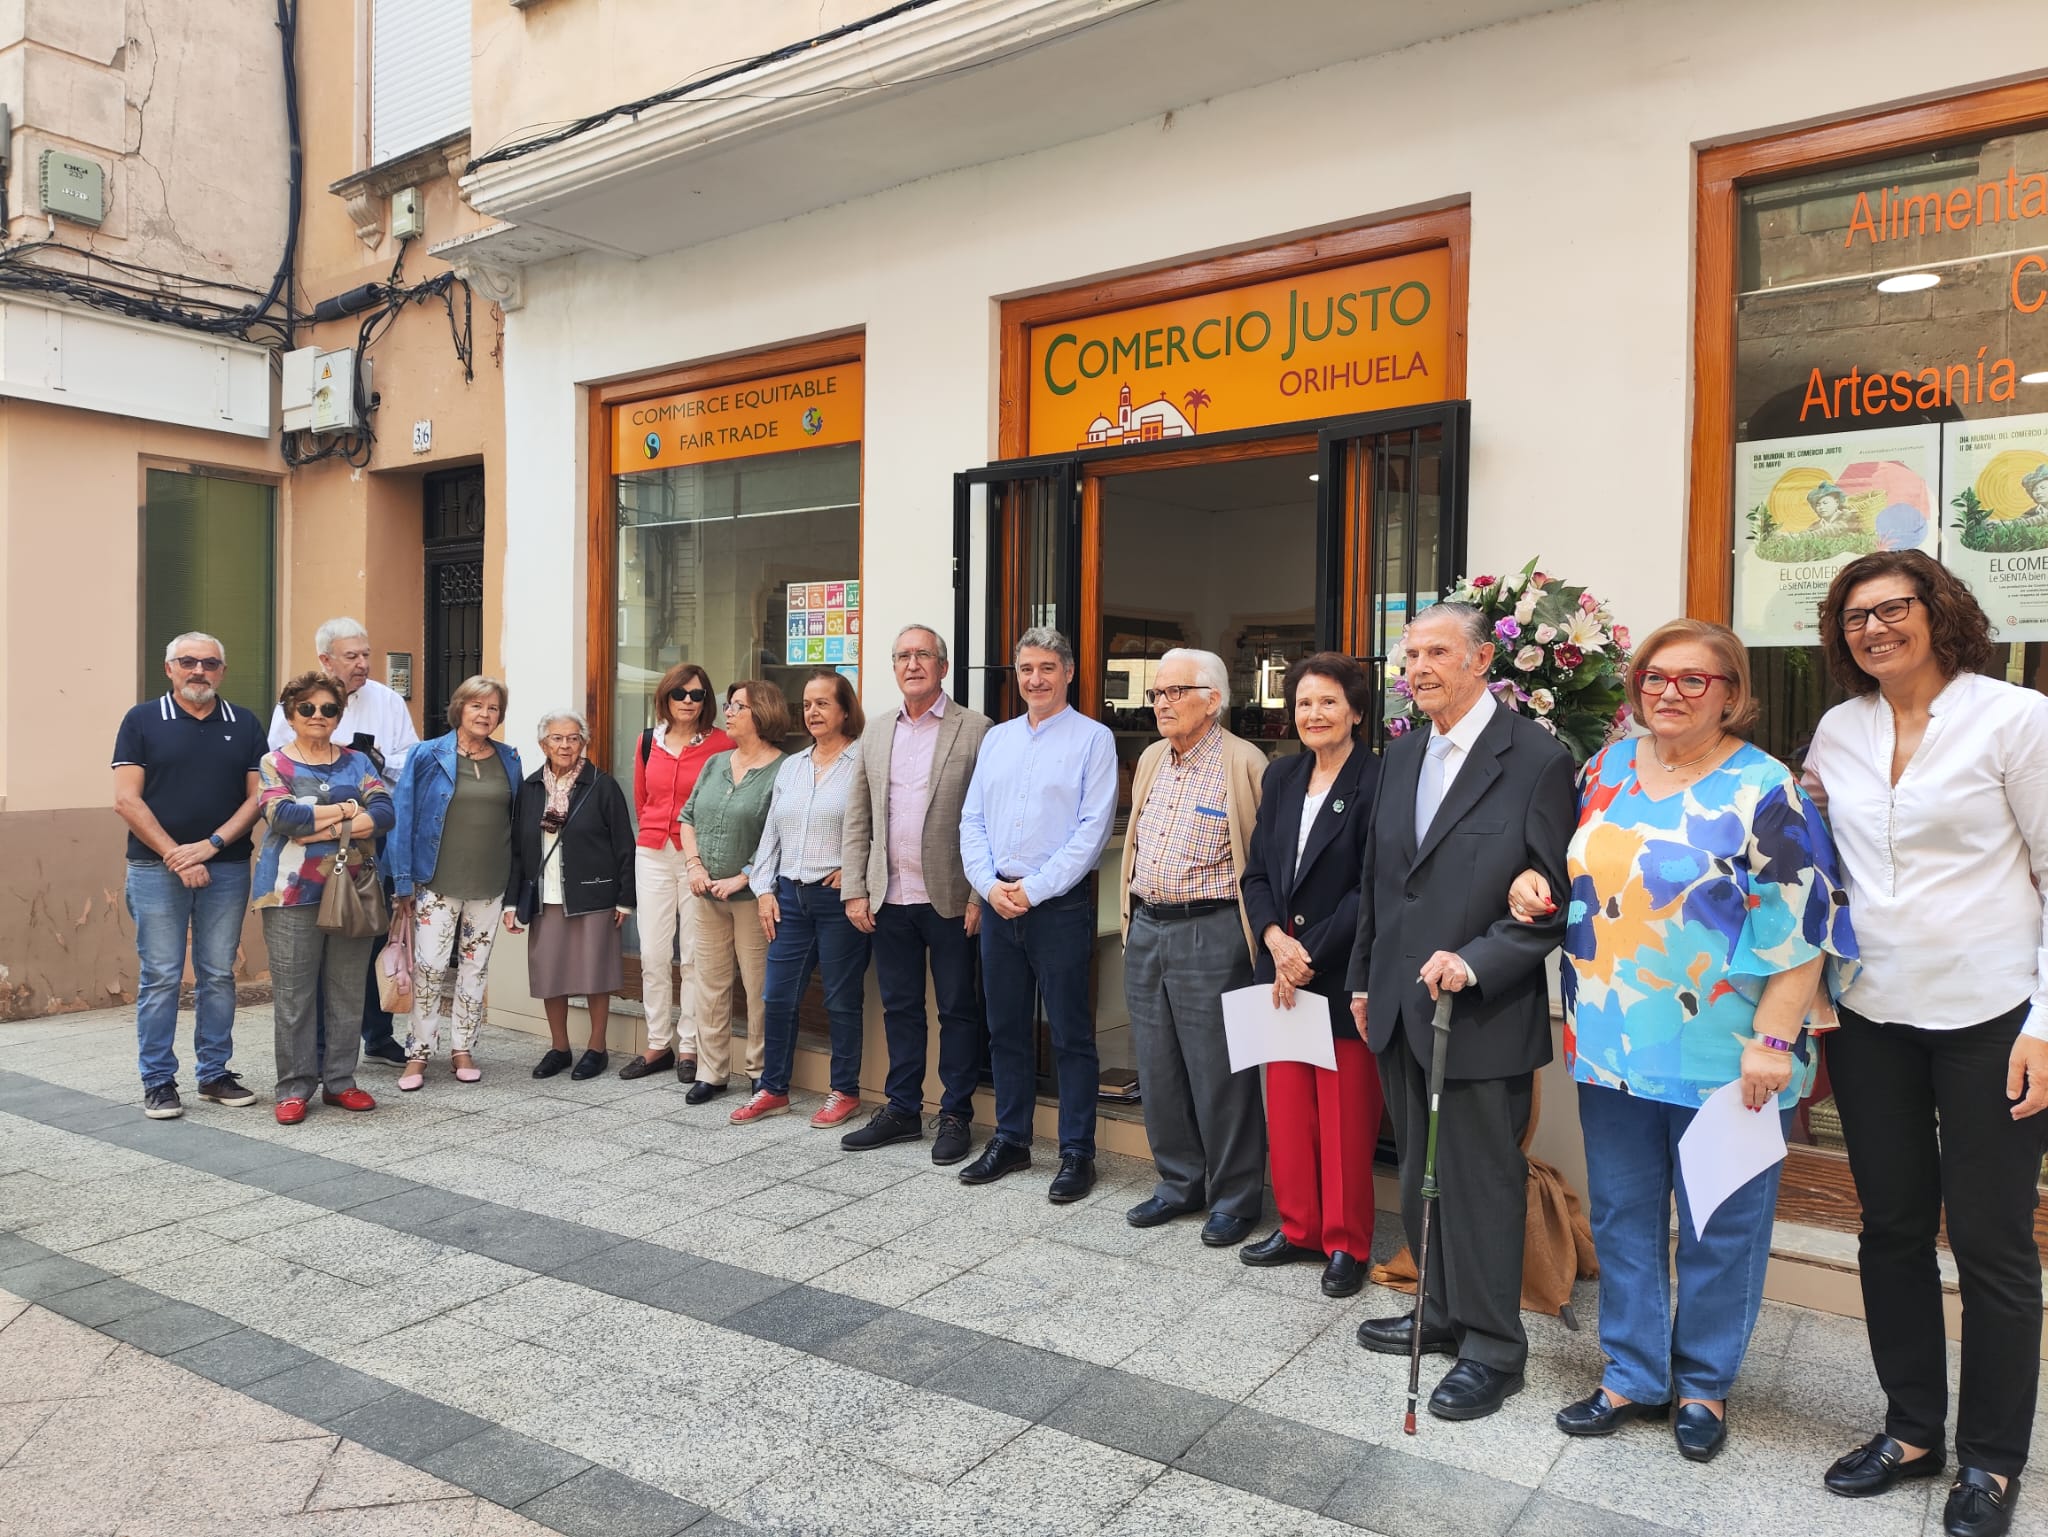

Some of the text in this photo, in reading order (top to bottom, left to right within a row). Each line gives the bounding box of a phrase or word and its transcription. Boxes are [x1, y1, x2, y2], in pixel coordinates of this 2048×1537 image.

[1844, 167, 2048, 248] Alimenta
[2011, 255, 2048, 313] C
[1044, 280, 1431, 396] COMERCIO JUSTO
[1279, 351, 1429, 397] ORIHUELA
[1800, 345, 2016, 421] Artesanía
[632, 376, 837, 426] COMMERCE EQUITABLE
[414, 425, 430, 445] 36
[680, 421, 779, 451] FAIR TRADE
[1971, 433, 1997, 442] MUNDIAL
[1998, 432, 2008, 440] DEL
[2011, 428, 2042, 438] COMERCIO
[1763, 452, 1786, 461] MUNDIAL
[1787, 450, 1796, 458] DEL
[1797, 448, 1824, 457] COMERCIO
[1825, 446, 1842, 455] JUSTO
[1965, 443, 1972, 451] DE
[1974, 442, 1991, 450] MAYO
[1758, 461, 1765, 469] DE
[1766, 460, 1781, 468] MAYO
[1990, 555, 2048, 572] EL COME
[1780, 568, 1792, 581] EL
[1989, 572, 2046, 582] Le SIENTA bien
[1788, 581, 1811, 590] SIENTA
[1812, 580, 1828, 589] bien
